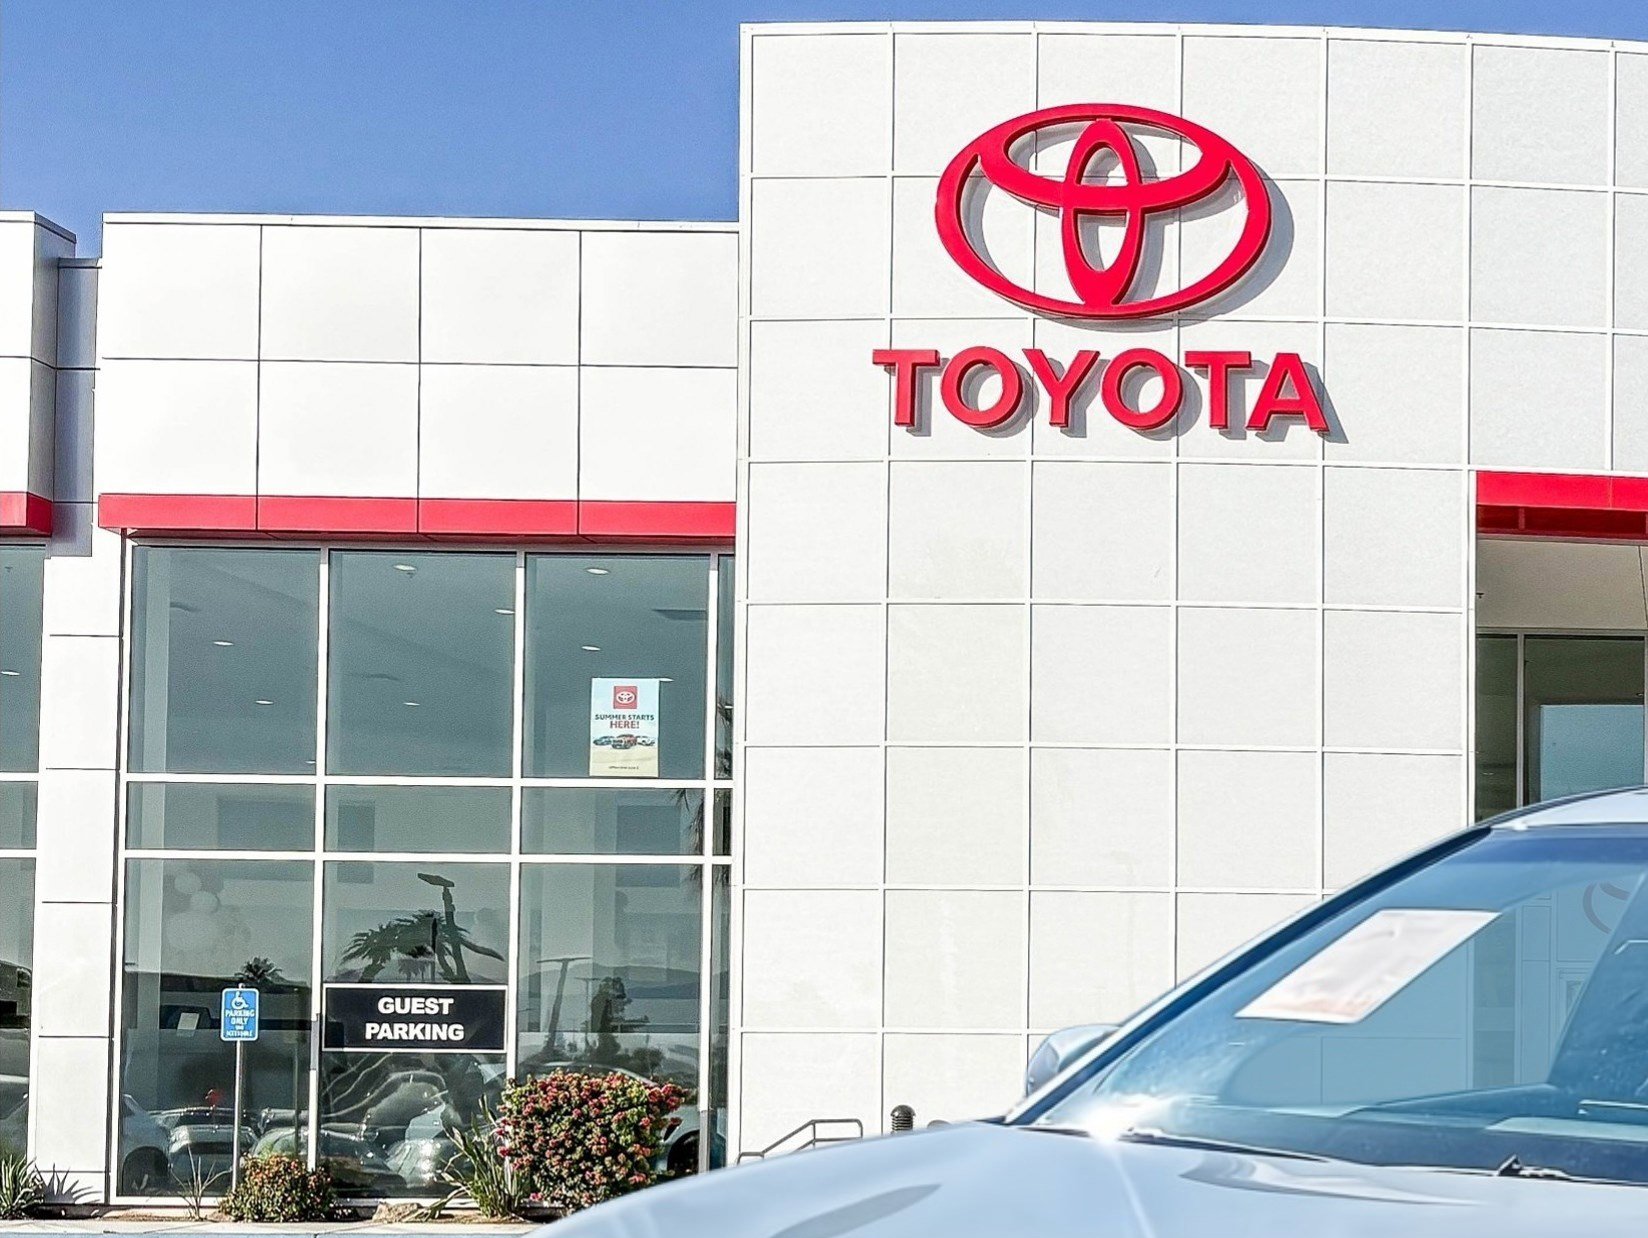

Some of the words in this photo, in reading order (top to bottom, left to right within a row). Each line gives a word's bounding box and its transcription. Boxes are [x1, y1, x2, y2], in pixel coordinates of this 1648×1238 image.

[872, 346, 1330, 432] TOYOTA
[609, 720, 640, 729] HERE!
[377, 997, 454, 1015] GUEST
[225, 1009, 255, 1018] PARKING
[230, 1017, 249, 1026] ONLY
[365, 1022, 465, 1041] PARKING
